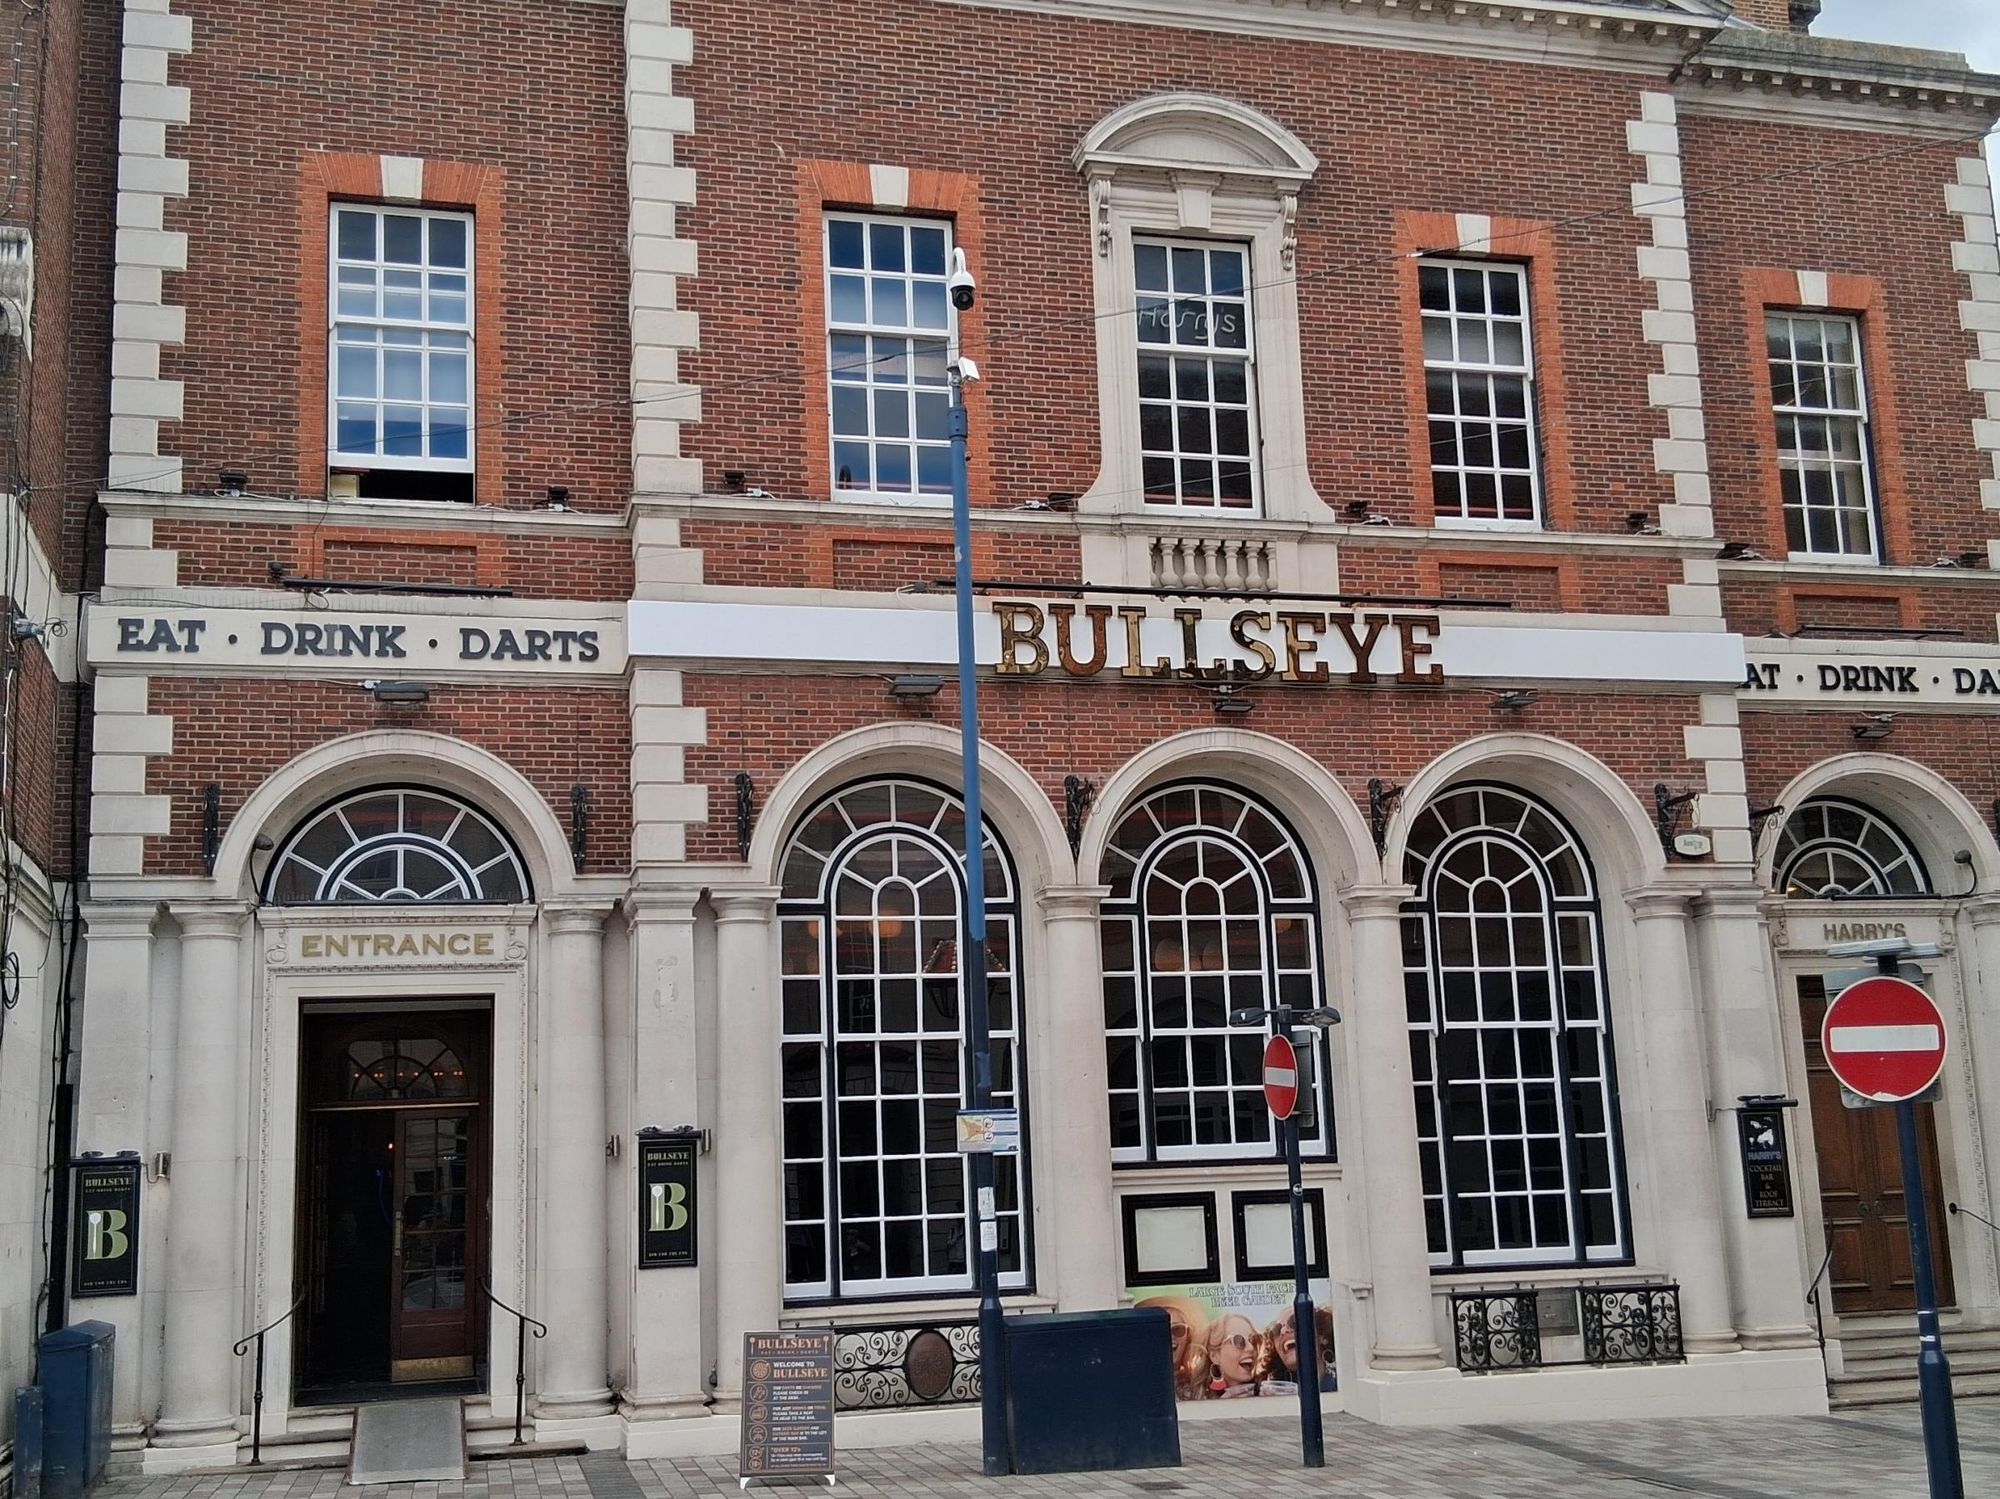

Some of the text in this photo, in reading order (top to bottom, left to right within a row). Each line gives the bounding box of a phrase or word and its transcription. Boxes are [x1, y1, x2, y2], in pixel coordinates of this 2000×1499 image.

[1138, 307, 1236, 340] Harry's
[117, 618, 599, 662] EAT DRINK DARTS
[992, 601, 1444, 685] BULLSEYE
[1735, 663, 2000, 694] AT DRINK DA
[1823, 922, 1906, 941] HARRY'S
[301, 932, 494, 957] ENTRANCE
[648, 1152, 690, 1161] BULLSEYE
[1748, 1151, 1781, 1161] HARRY'S
[85, 1177, 132, 1187] BULLSEYE
[648, 1182, 688, 1232] B
[84, 1209, 128, 1260] B
[1189, 1287, 1225, 1297] LARGE
[1242, 1294, 1286, 1305] GARDEN
[758, 1338, 821, 1349] BULLSEYE
[773, 1368, 827, 1378] BULLSEYE
